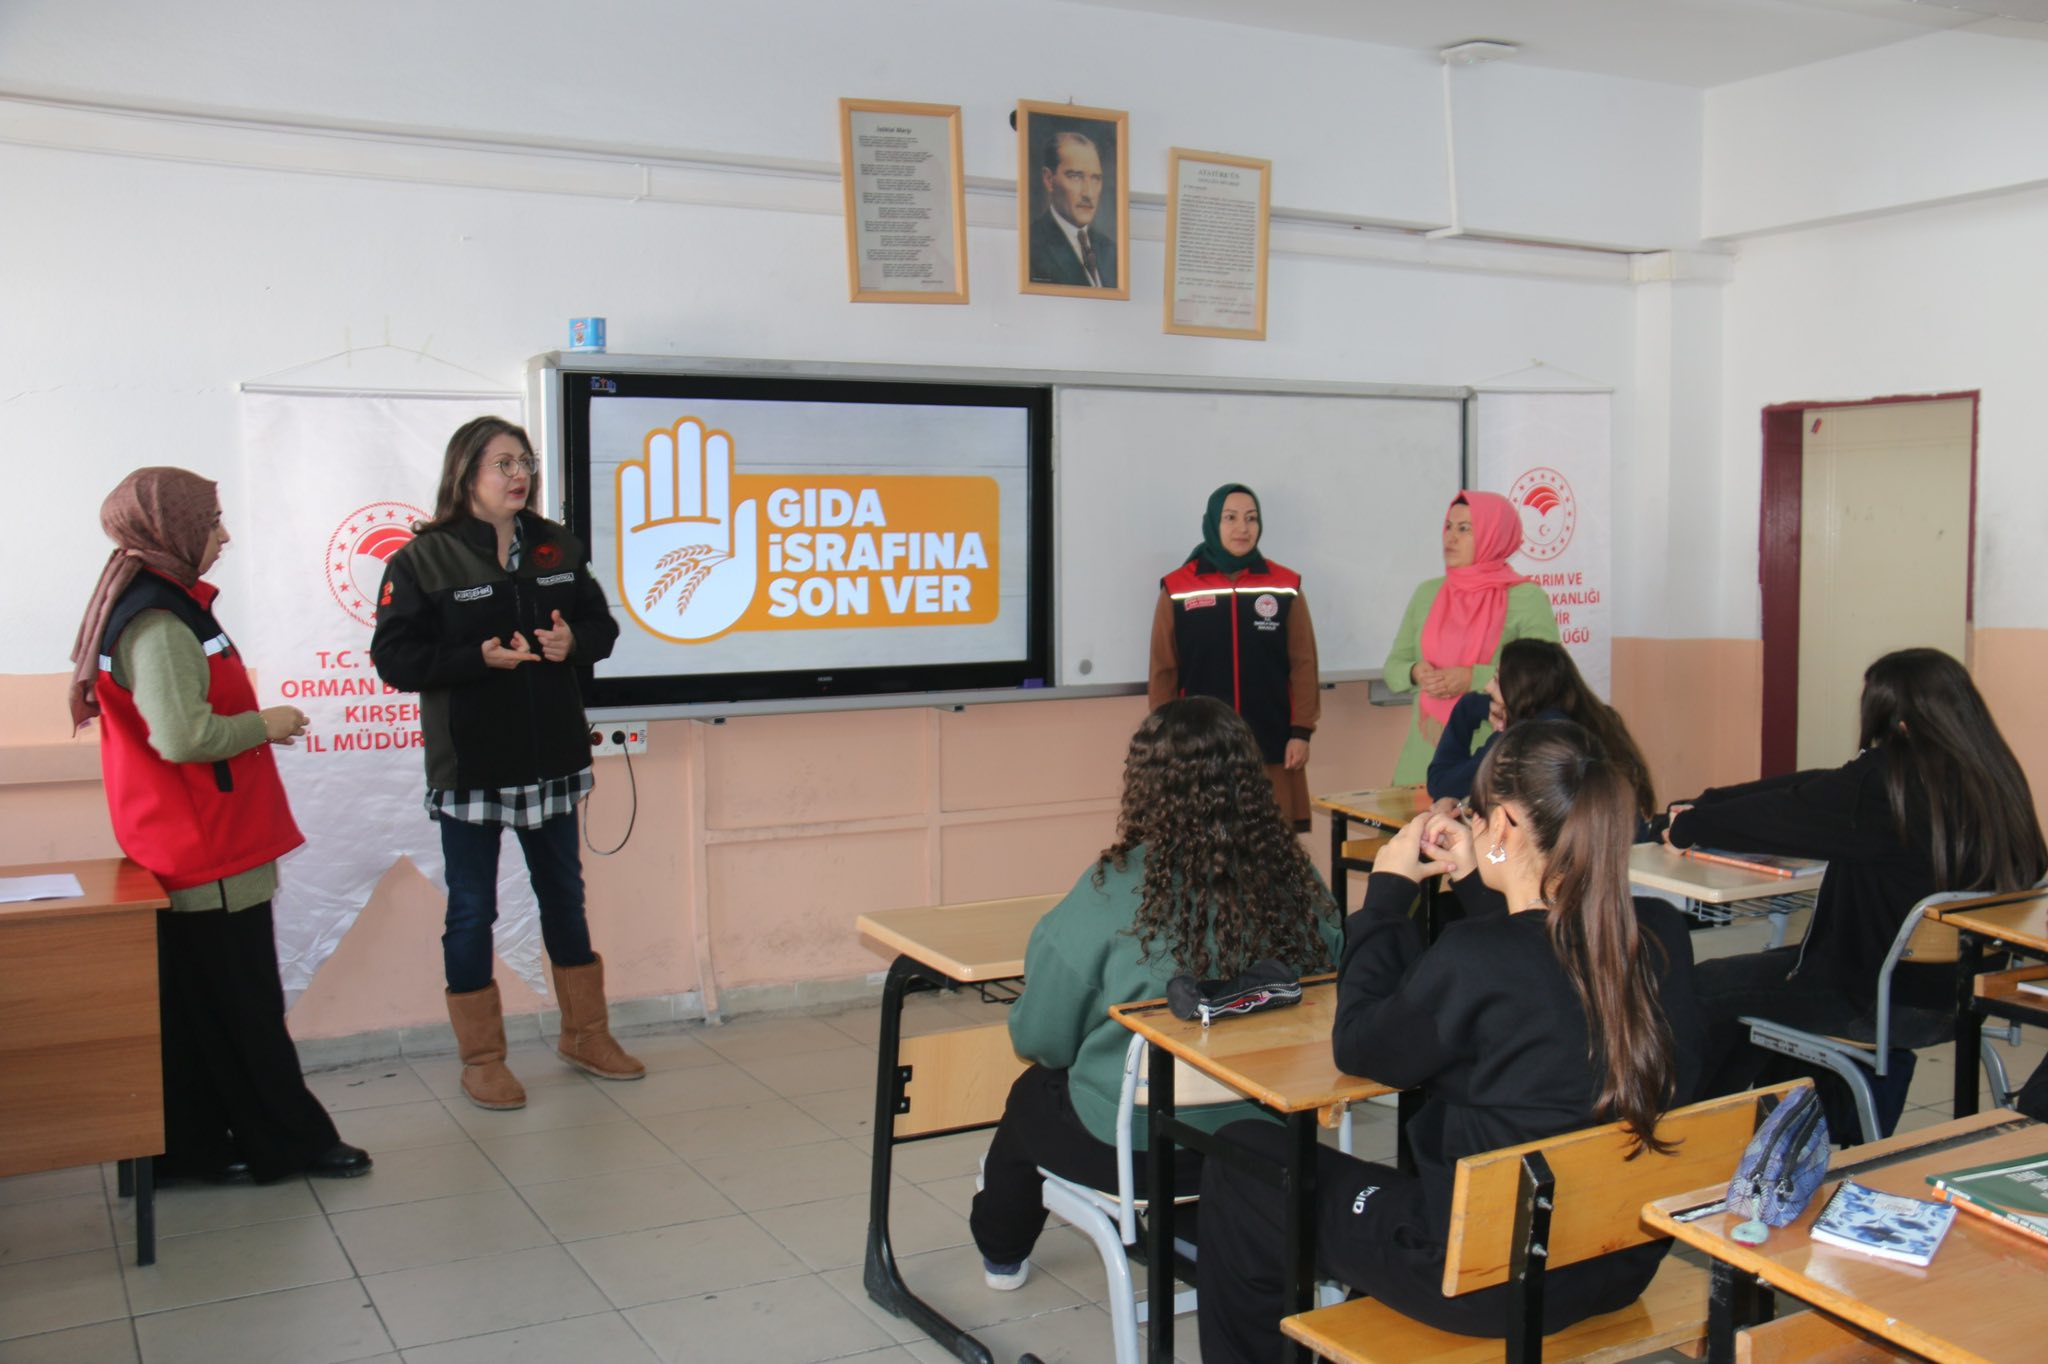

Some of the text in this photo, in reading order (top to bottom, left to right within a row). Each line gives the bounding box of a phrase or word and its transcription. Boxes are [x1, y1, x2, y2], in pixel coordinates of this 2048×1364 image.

[767, 488, 886, 528] GIDA
[1568, 572, 1582, 585] VE
[768, 575, 971, 617] SON VER
[316, 651, 359, 669] T.C.
[281, 678, 376, 698] ORMAN
[306, 731, 327, 753] İL
